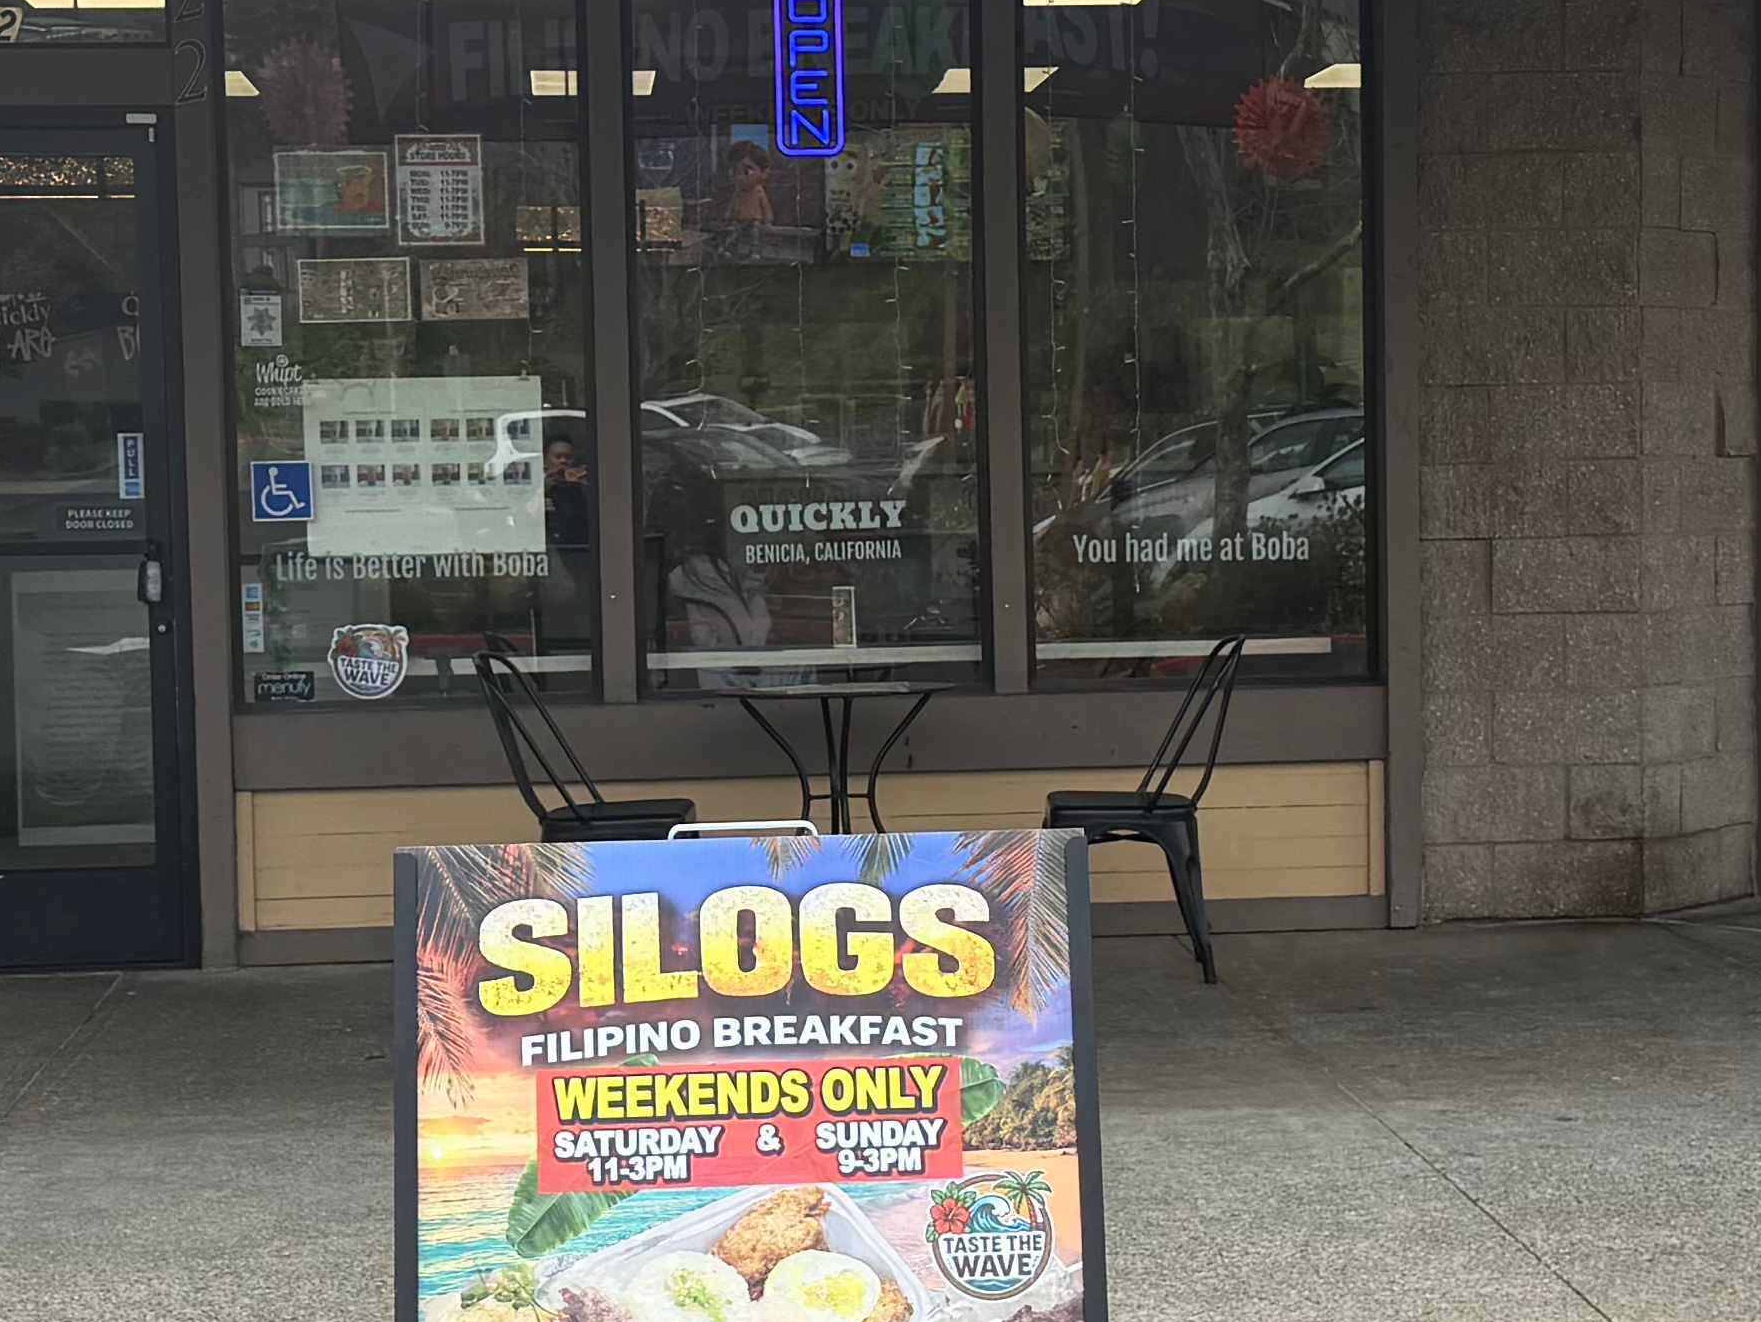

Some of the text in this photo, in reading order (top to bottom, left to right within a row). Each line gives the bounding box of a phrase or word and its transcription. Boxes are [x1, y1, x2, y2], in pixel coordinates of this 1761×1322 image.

[125, 439, 137, 477] PULL
[65, 520, 134, 529] DOOR CLOSED
[68, 509, 131, 519] PLEASE KEEP
[730, 499, 906, 534] QUICKLY
[745, 539, 902, 566] BENICIA, CALIFORNIA
[1072, 530, 1310, 564] You had me at Boba
[275, 548, 550, 582] Life is Better with Boba
[340, 657, 398, 674] TASTE THE
[343, 669, 391, 686] WAVE
[477, 881, 997, 1017] SILOGS
[520, 1015, 964, 1067] FILIPINO BREAKFAST
[553, 1065, 944, 1122] WEEKENDS ONLY
[554, 1119, 946, 1159] SATURDAY & SUNDAY
[587, 1147, 922, 1183] 11-3PM 9-3PM
[942, 1234, 1043, 1255] TASTE THE
[952, 1254, 1033, 1278] WAVE
